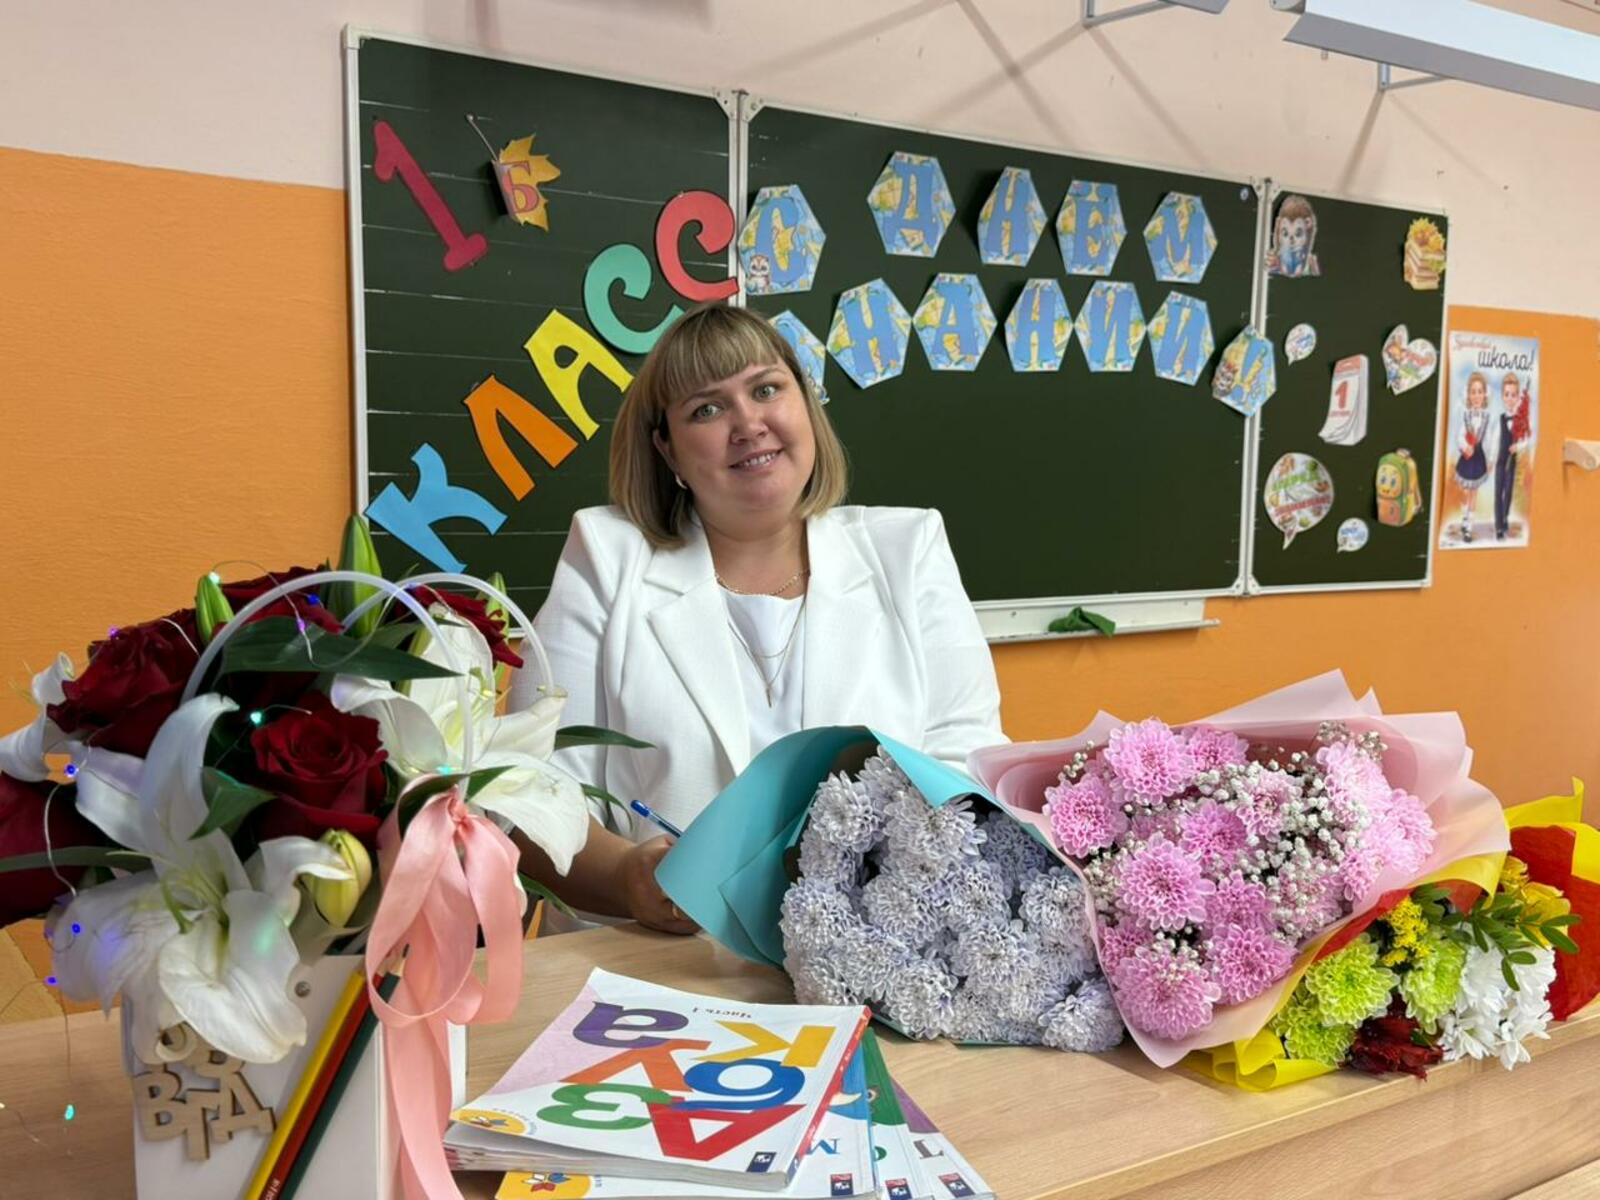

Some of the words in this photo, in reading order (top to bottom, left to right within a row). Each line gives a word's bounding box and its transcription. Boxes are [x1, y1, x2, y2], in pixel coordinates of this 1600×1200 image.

[374, 120, 488, 271] 1
[500, 160, 540, 214] Б
[755, 197, 807, 287] С
[364, 190, 740, 573] КЛАСС
[1335, 381, 1348, 409] 1
[1477, 346, 1535, 372] школа!
